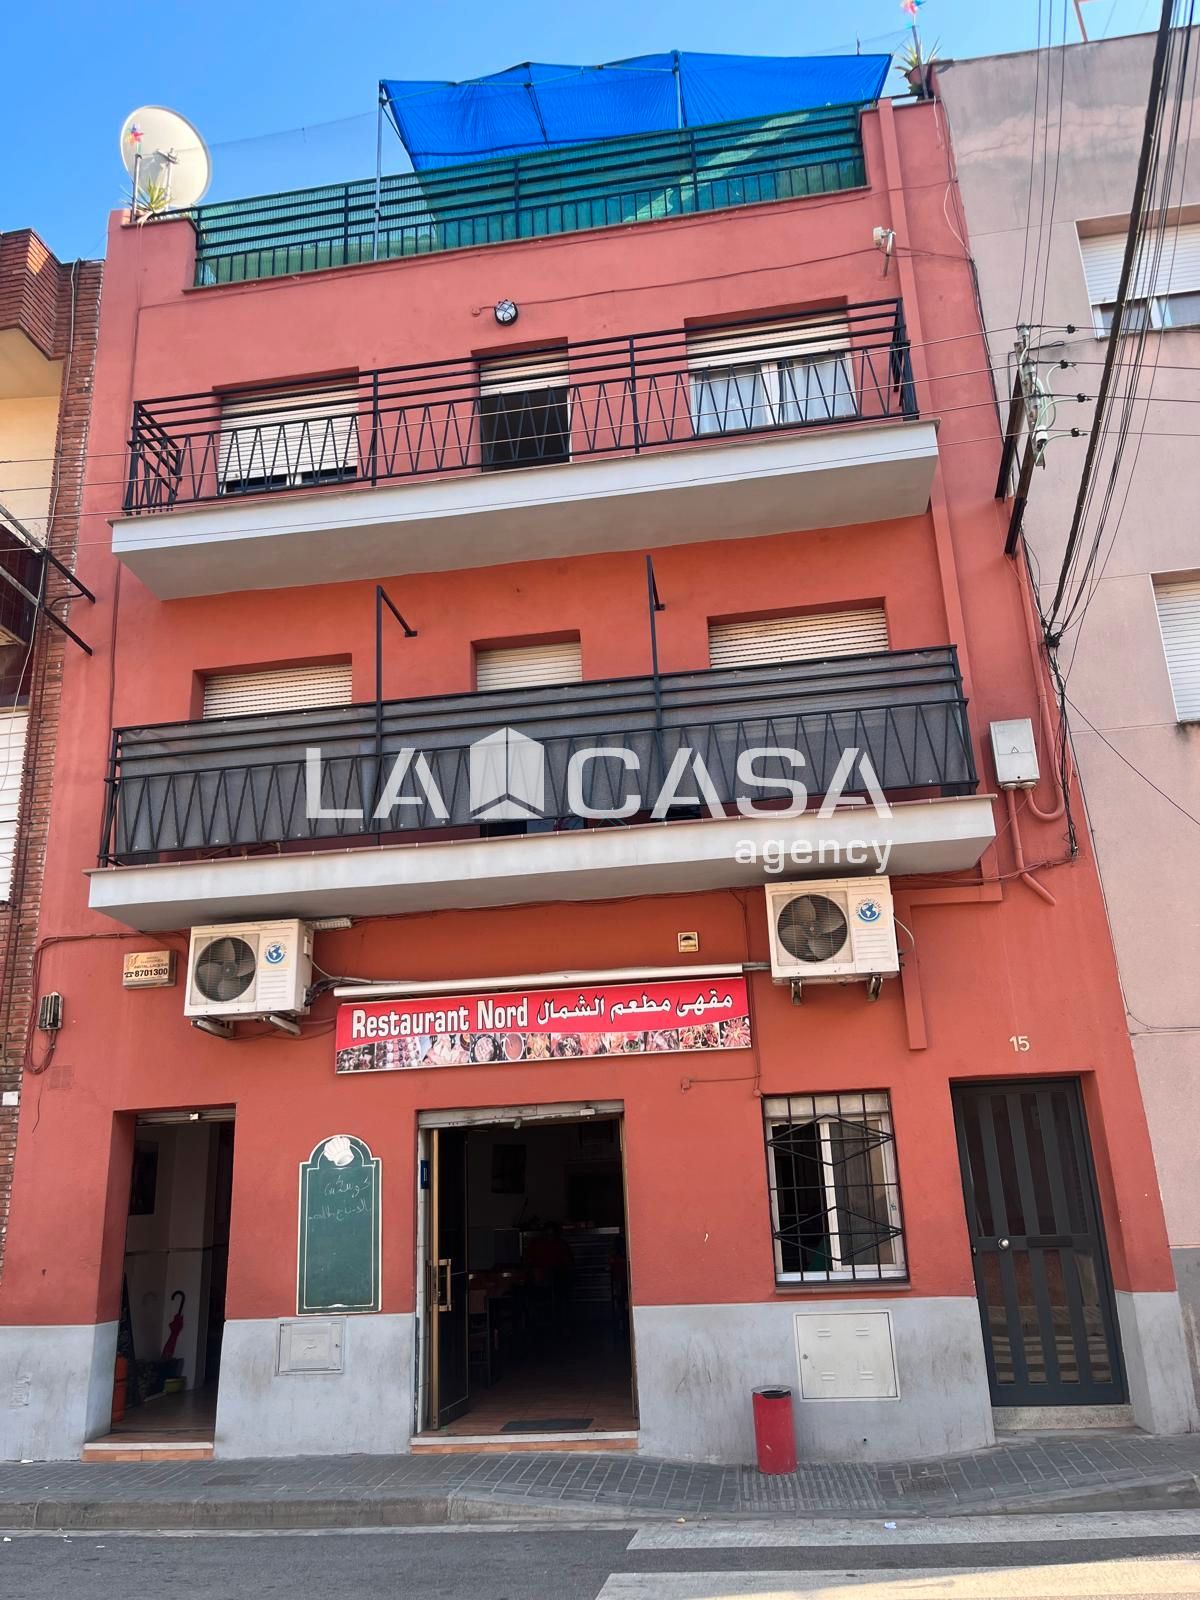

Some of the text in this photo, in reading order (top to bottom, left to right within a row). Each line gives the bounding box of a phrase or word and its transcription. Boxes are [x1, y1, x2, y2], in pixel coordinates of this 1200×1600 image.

[134, 967, 168, 978] 8701300
[351, 997, 529, 1039] Restaurant Nord
[536, 989, 733, 1025] مقهى مطعم الشمال
[1009, 1035, 1030, 1052] 15
